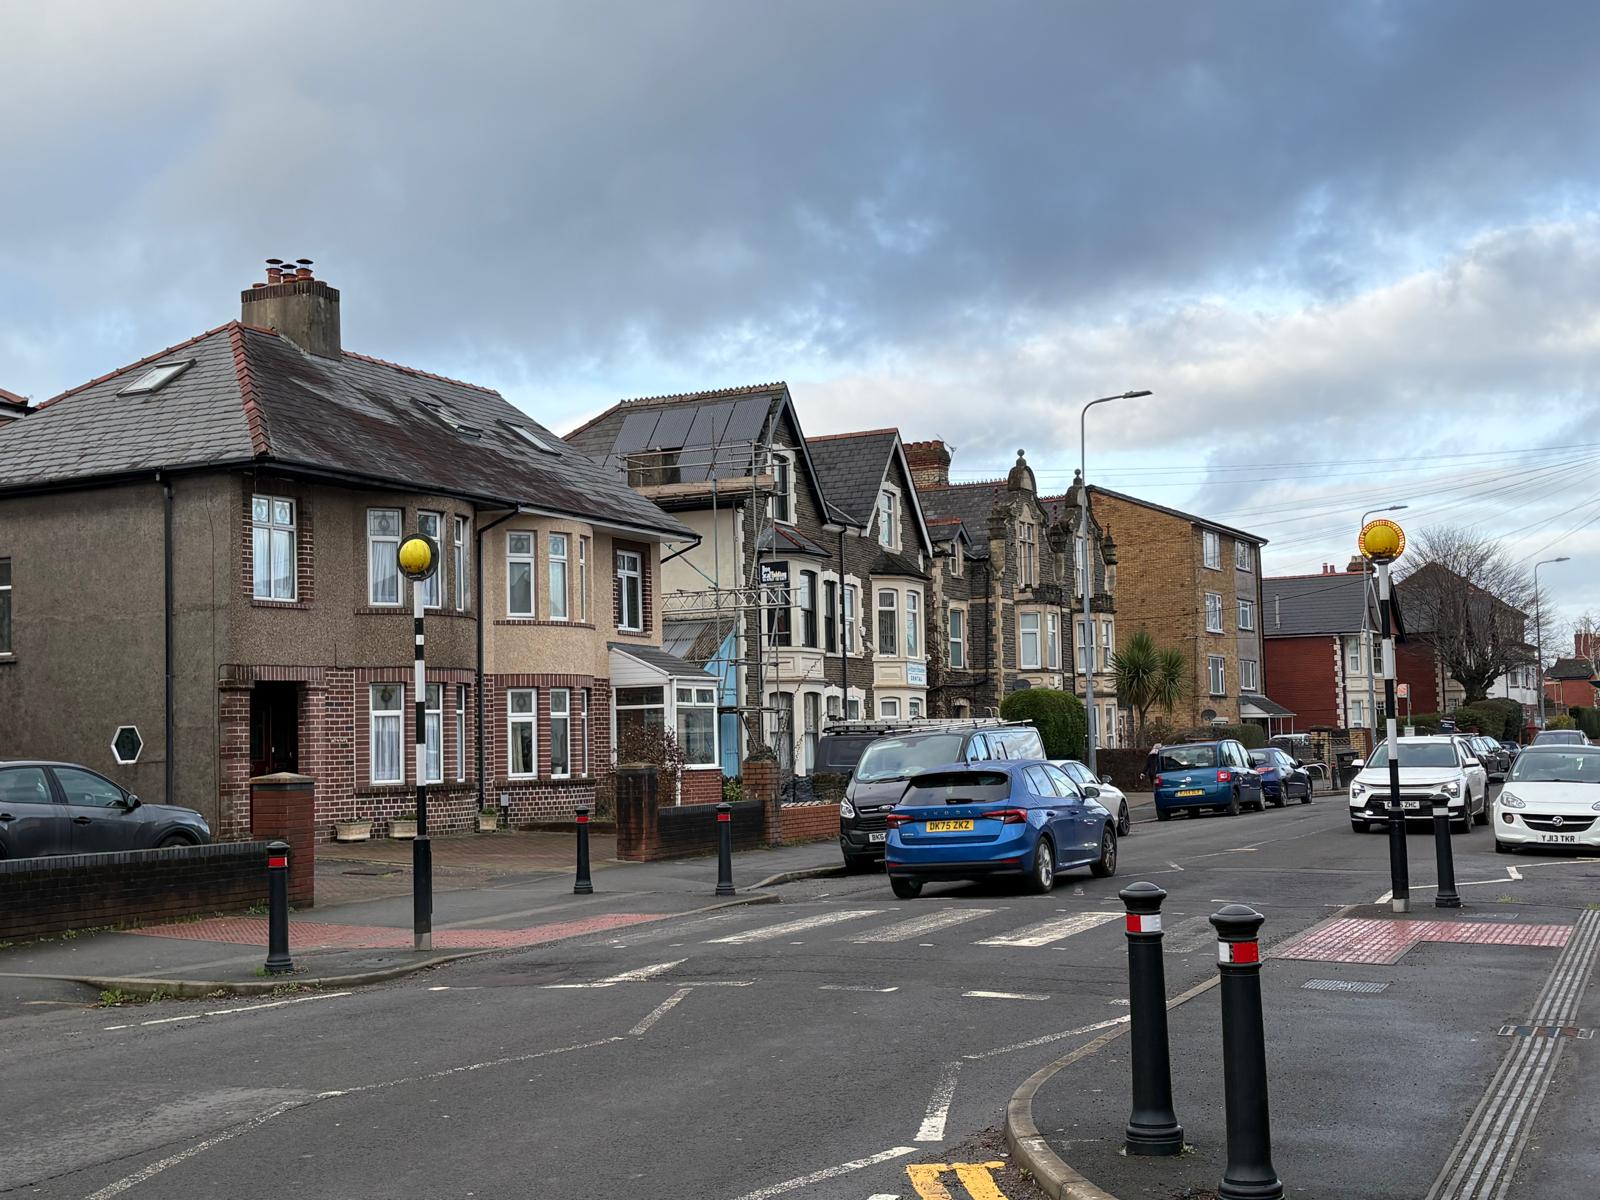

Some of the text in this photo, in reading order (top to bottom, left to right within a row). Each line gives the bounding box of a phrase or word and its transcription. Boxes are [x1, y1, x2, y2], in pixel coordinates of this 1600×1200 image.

[930, 820, 970, 831] DK75 ZKZ
[1560, 835, 1576, 843] TKR
